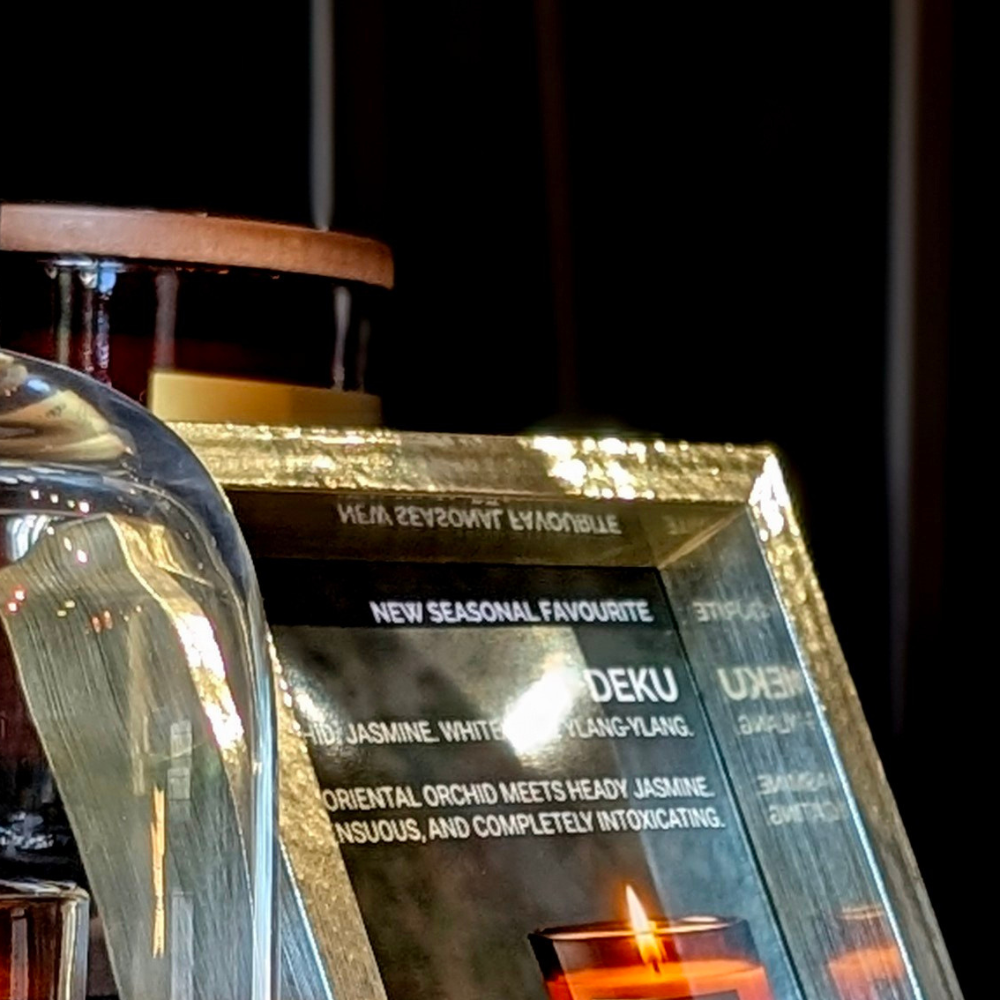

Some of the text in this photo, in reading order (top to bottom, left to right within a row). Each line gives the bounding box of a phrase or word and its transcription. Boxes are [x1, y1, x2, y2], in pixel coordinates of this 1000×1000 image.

[368, 599, 655, 624] NEW SEASONAL FAVOURITE
[584, 667, 679, 703] DEKU
[346, 719, 441, 745] JASMINE.
[438, 719, 503, 743] WHITE
[565, 714, 695, 738] YLANG-YLANG.
[322, 776, 716, 812] ORIENTAL ORCHID MEETS HEADY JASMINE.
[428, 815, 471, 840] AND
[472, 809, 593, 838] COMPLETELY
[596, 806, 726, 834] INTOXICATING.
